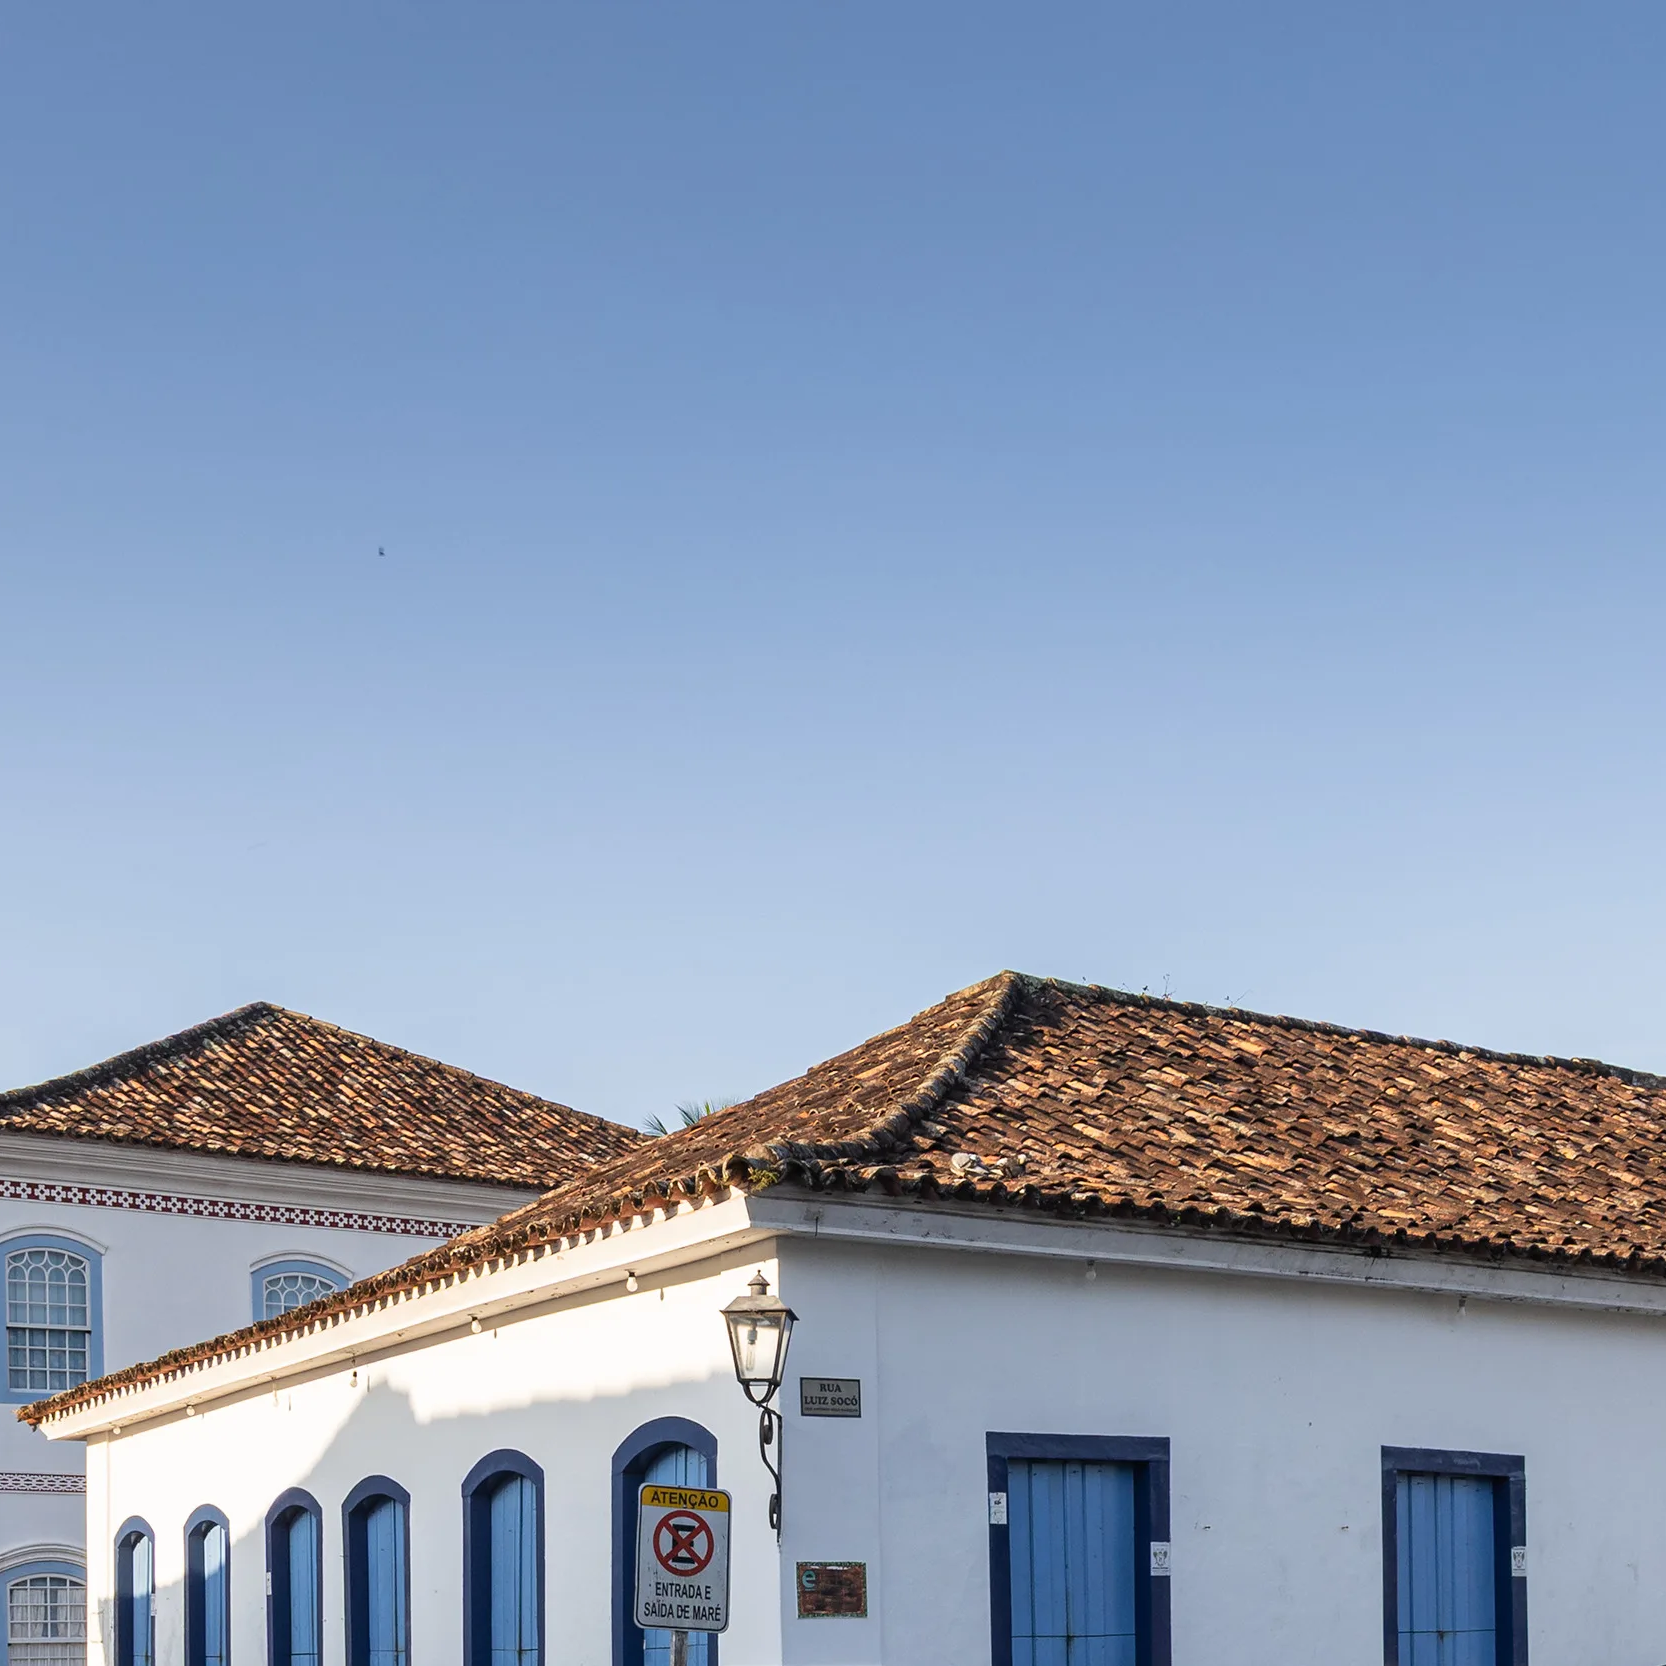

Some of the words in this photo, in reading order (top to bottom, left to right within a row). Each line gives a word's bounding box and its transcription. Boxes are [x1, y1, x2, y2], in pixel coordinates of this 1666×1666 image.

[819, 1383, 842, 1393] RUA
[804, 1395, 829, 1405] LUIZ
[830, 1395, 858, 1406] SOCÓ
[651, 1489, 719, 1509] ATENÇÃO
[655, 1582, 702, 1599] ENTRADA
[704, 1585, 711, 1600] E
[677, 1604, 690, 1619] DE
[693, 1604, 721, 1621] MARÉ
